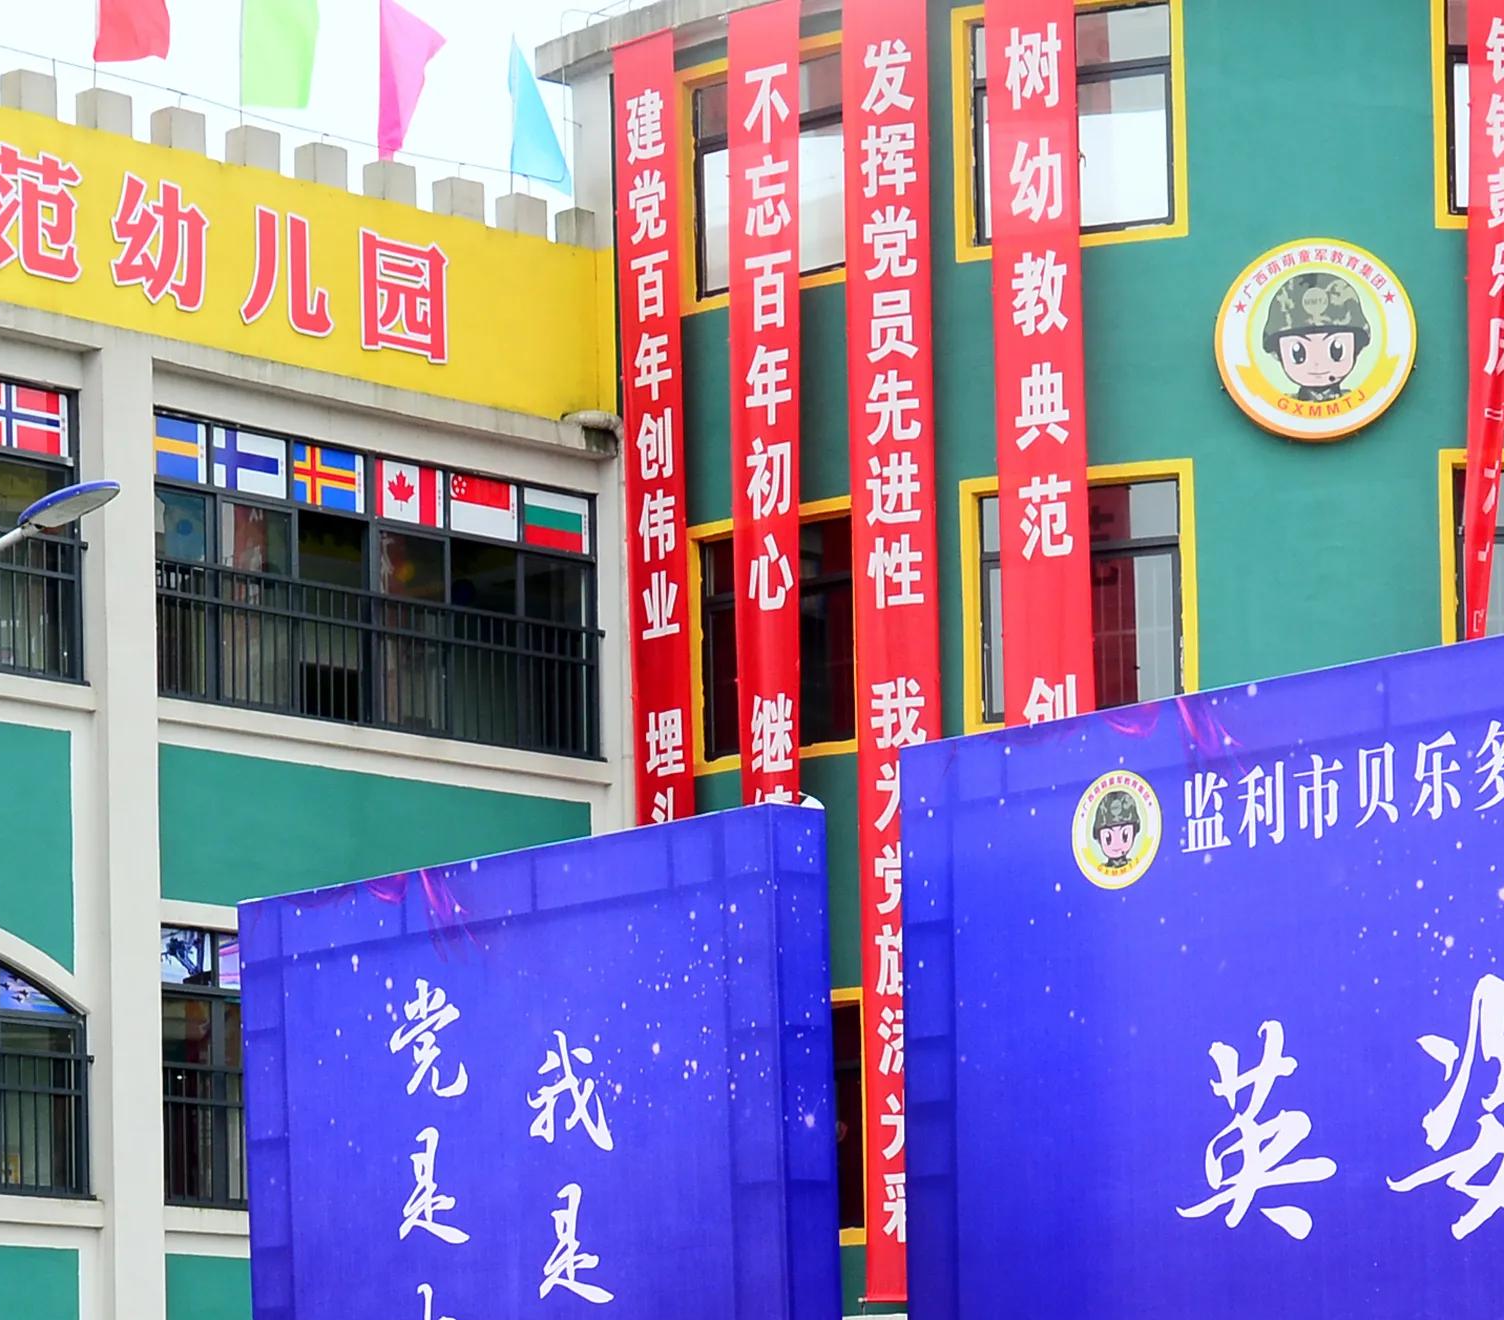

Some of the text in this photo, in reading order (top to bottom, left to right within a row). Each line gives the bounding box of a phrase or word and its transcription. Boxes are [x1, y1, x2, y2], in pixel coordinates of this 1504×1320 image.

[626, 88, 680, 641] 建党百年创伟业
[743, 62, 794, 805] 不忘百年初心 继
[860, 38, 925, 609] 发挥党员先进性
[1005, 22, 1073, 560] 树幼教典范
[1243, 249, 1387, 299] 广西萌萌童军教育集团
[1277, 389, 1366, 418] GXMMTJ
